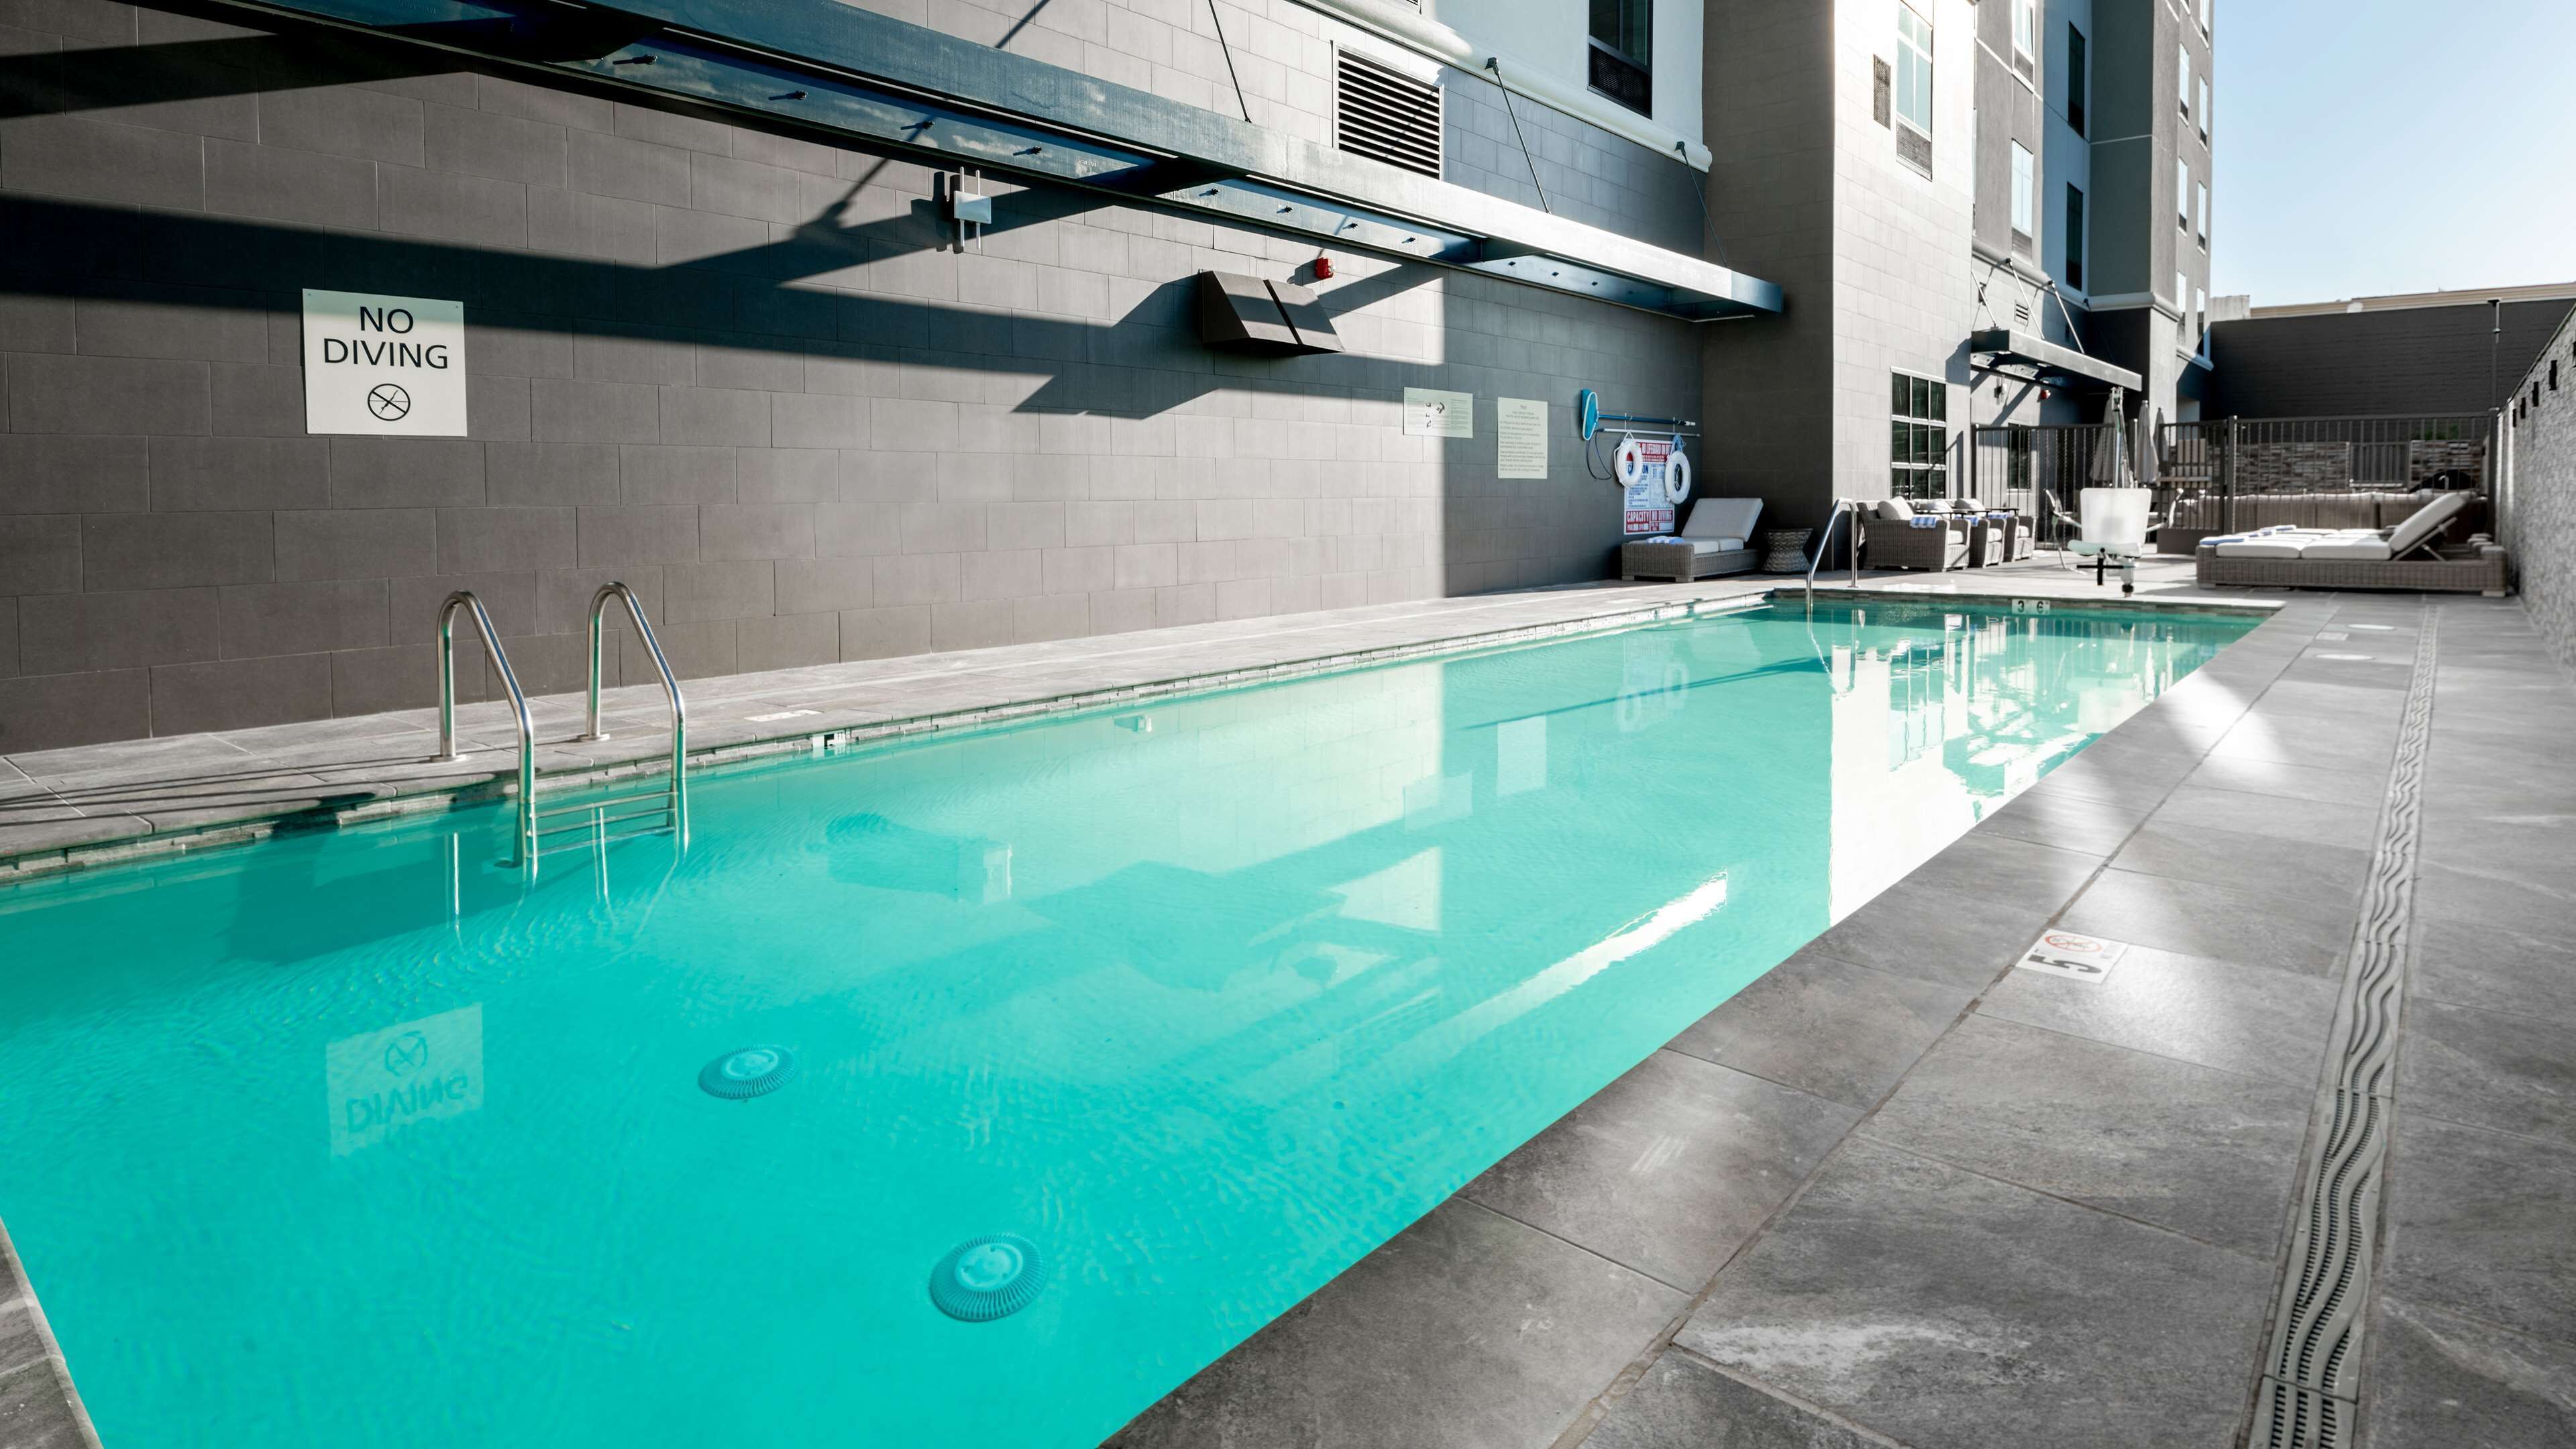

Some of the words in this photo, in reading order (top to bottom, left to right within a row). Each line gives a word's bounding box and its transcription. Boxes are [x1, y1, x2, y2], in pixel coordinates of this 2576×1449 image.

[360, 306, 414, 334] NO
[323, 338, 448, 369] DIVING
[1627, 511, 1650, 523] CAPACITY
